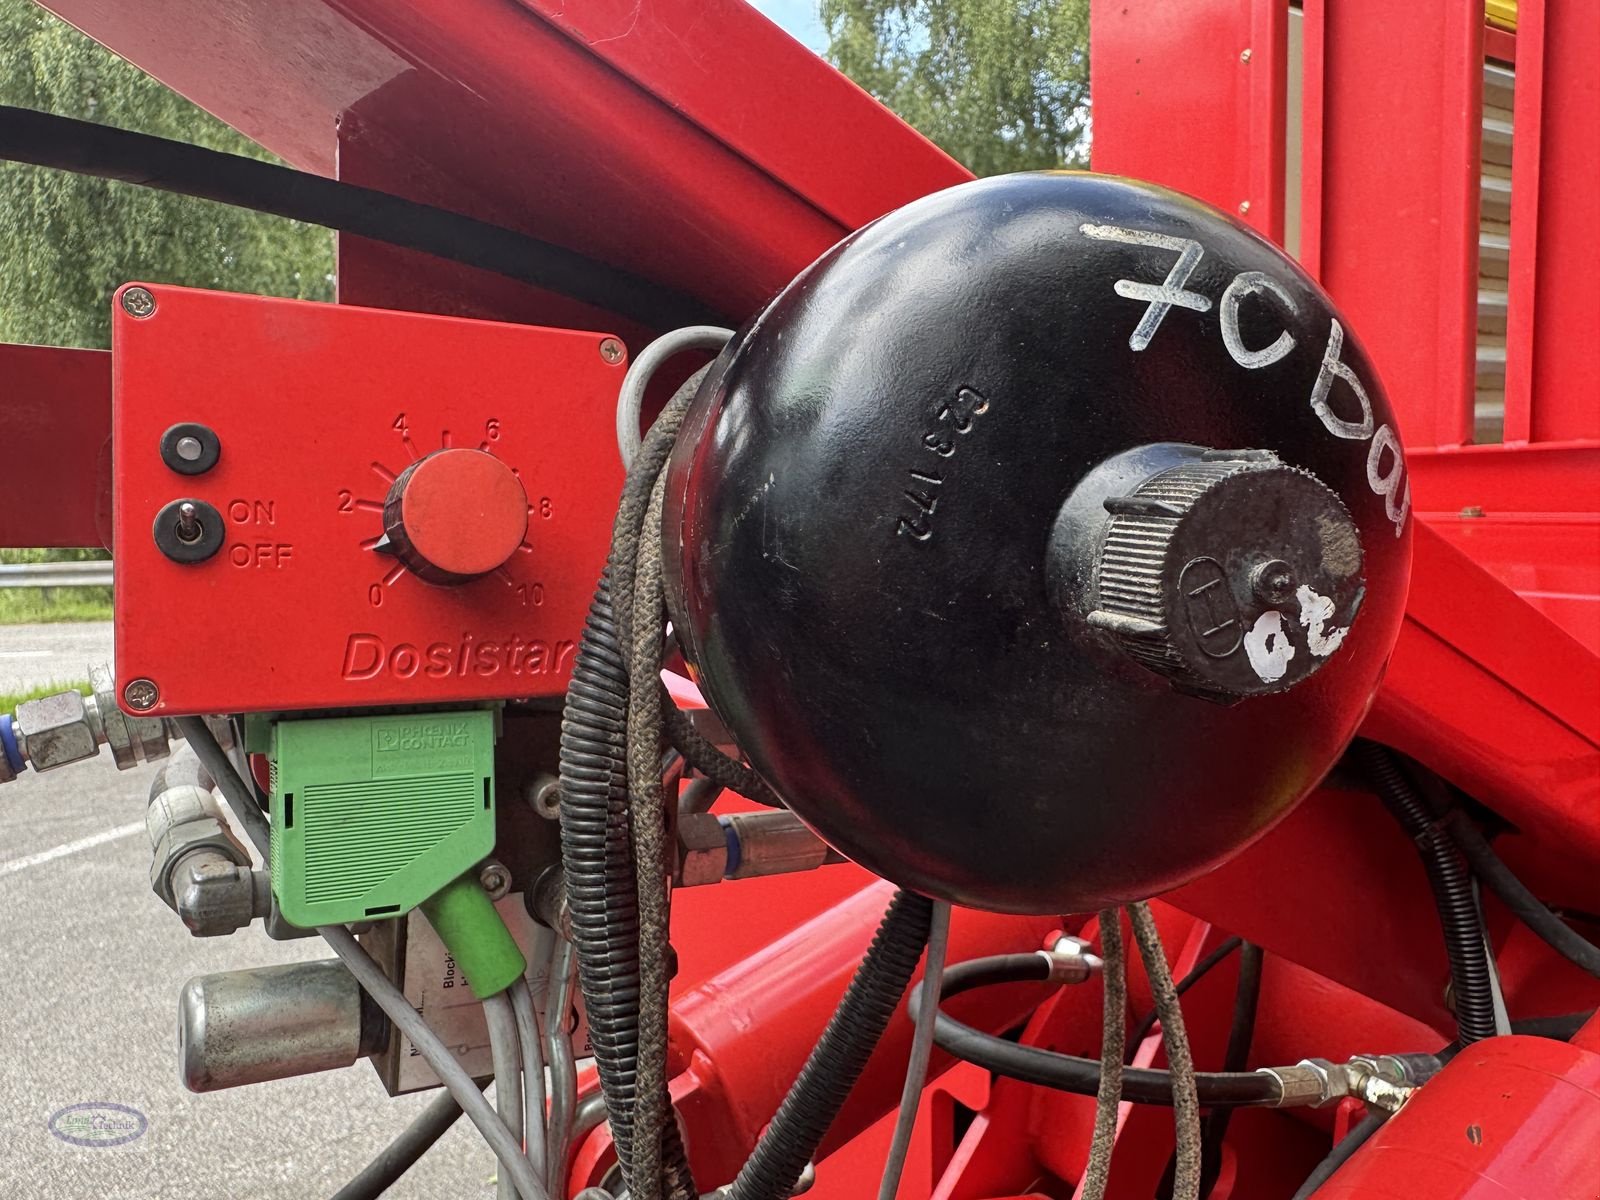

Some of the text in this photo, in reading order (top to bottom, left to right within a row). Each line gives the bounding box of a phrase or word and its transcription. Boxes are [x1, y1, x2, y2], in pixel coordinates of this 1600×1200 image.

[392, 412, 410, 434] 4
[486, 418, 501, 441] 6
[227, 499, 275, 526] ON
[338, 489, 355, 513] 2
[539, 497, 554, 520] 8
[228, 543, 293, 569] OFF
[368, 583, 383, 608] 0
[517, 582, 544, 606] 10
[342, 631, 575, 681] Dosistar
[401, 735, 470, 750] CONTACT
